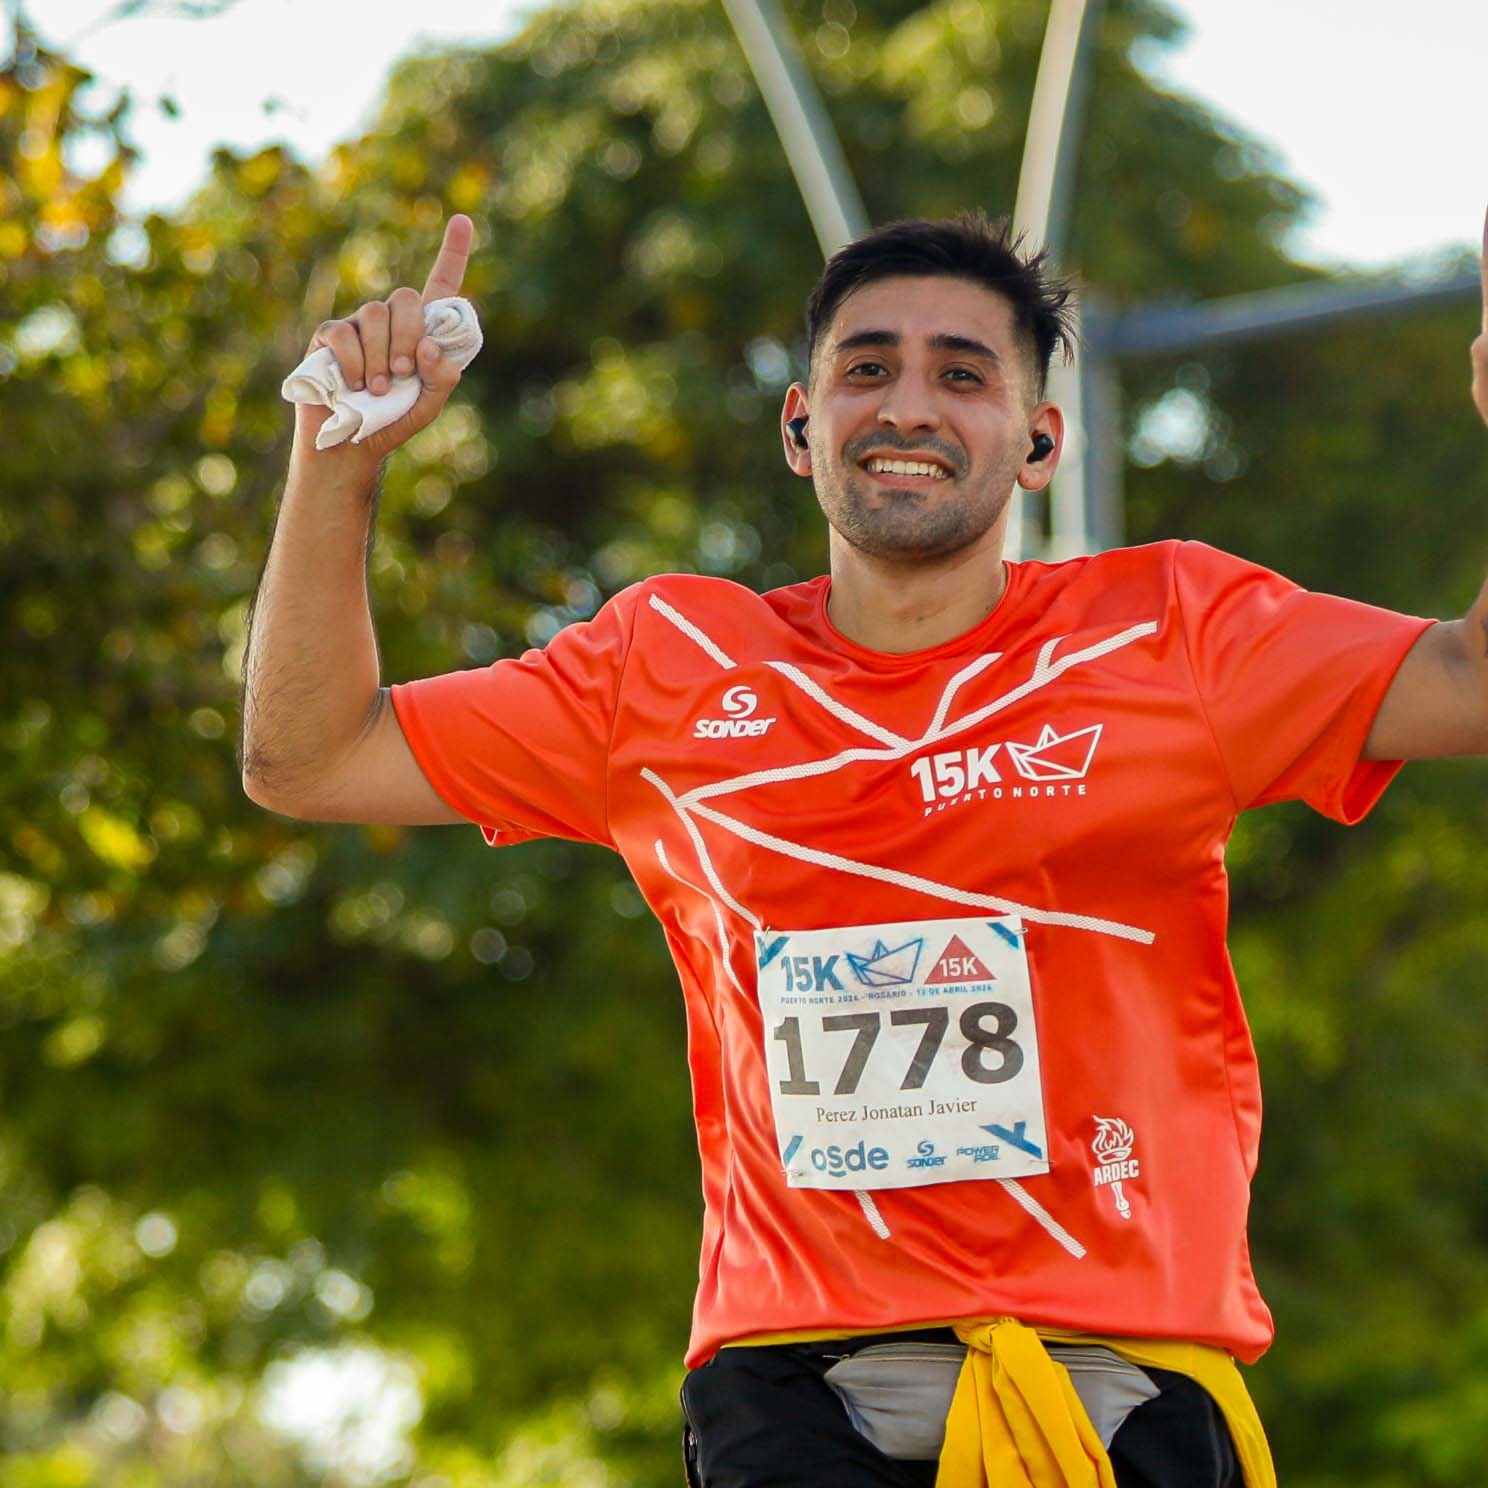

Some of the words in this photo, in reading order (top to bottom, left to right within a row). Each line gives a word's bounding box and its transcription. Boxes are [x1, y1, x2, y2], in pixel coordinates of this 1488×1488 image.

[910, 742, 1003, 803] 15K
[1012, 783, 1087, 798] NORTE
[779, 954, 846, 993] 15K
[938, 956, 979, 978] 15K
[929, 986, 941, 996] DE
[943, 984, 968, 995] ABRIL
[773, 1001, 1025, 1096] 1778
[815, 1106, 858, 1123] Perez
[862, 1104, 924, 1121] Jonatan
[927, 1097, 979, 1117] Javier
[811, 1139, 890, 1177] osde
[1093, 1159, 1140, 1186] ARDEC
